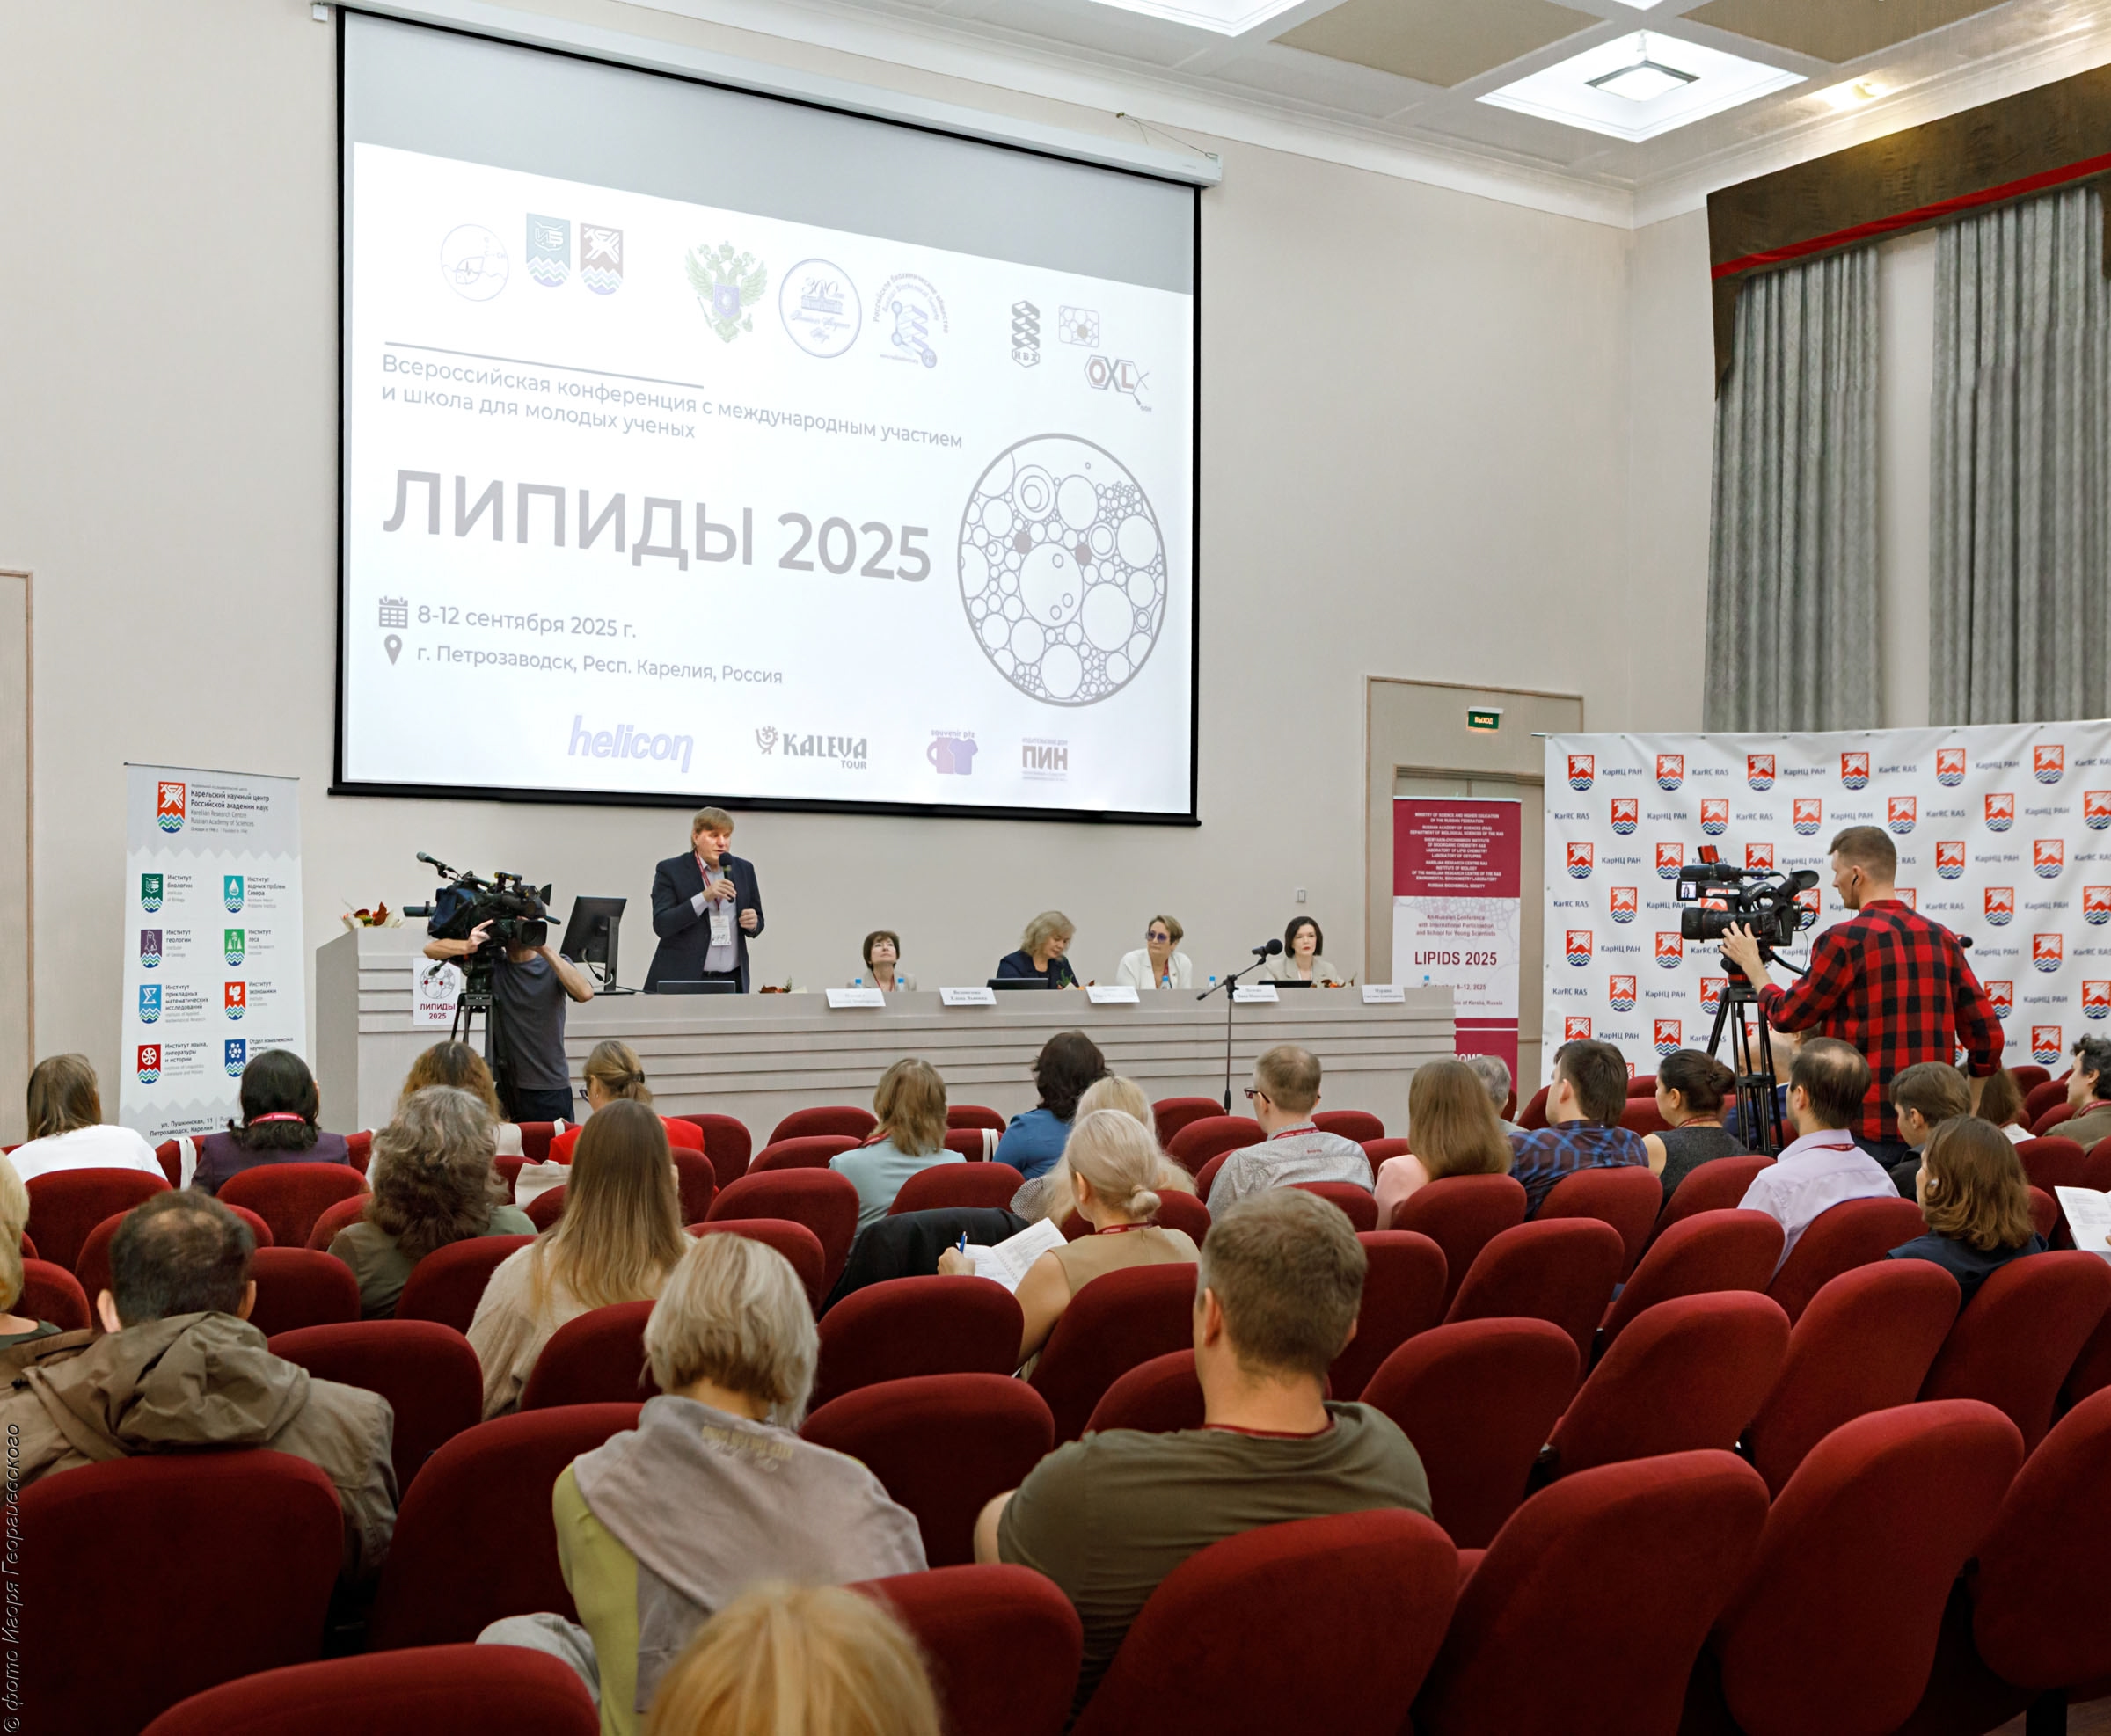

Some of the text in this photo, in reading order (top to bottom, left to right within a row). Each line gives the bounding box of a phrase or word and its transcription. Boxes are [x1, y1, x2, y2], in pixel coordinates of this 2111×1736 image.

[383, 354, 962, 448] Всероссийская конференция с международным участием
[383, 386, 696, 438] и школа для молодых ученых
[383, 469, 931, 582] ЛИПИДЫ 2025
[418, 606, 637, 638] 8-12 сентября 2025 г.
[418, 646, 783, 684] г. Петрозаводск, Респ. Карелия, Россия
[568, 714, 693, 773] helicon
[783, 733, 867, 760] KALEVA
[841, 760, 866, 770] TOUR
[1022, 745, 1068, 770] ПИН
[1879, 765, 1900, 774] KarRC
[1951, 809, 1966, 818] RAS
[1782, 858, 1807, 867] КарНЦ
[1647, 901, 1670, 910] КарНЦ
[1415, 951, 1497, 966] LIPIDS 2025
[1599, 1032, 1623, 1040] КарНЦ
[150, 1128, 189, 1137] Петрозаводск,
